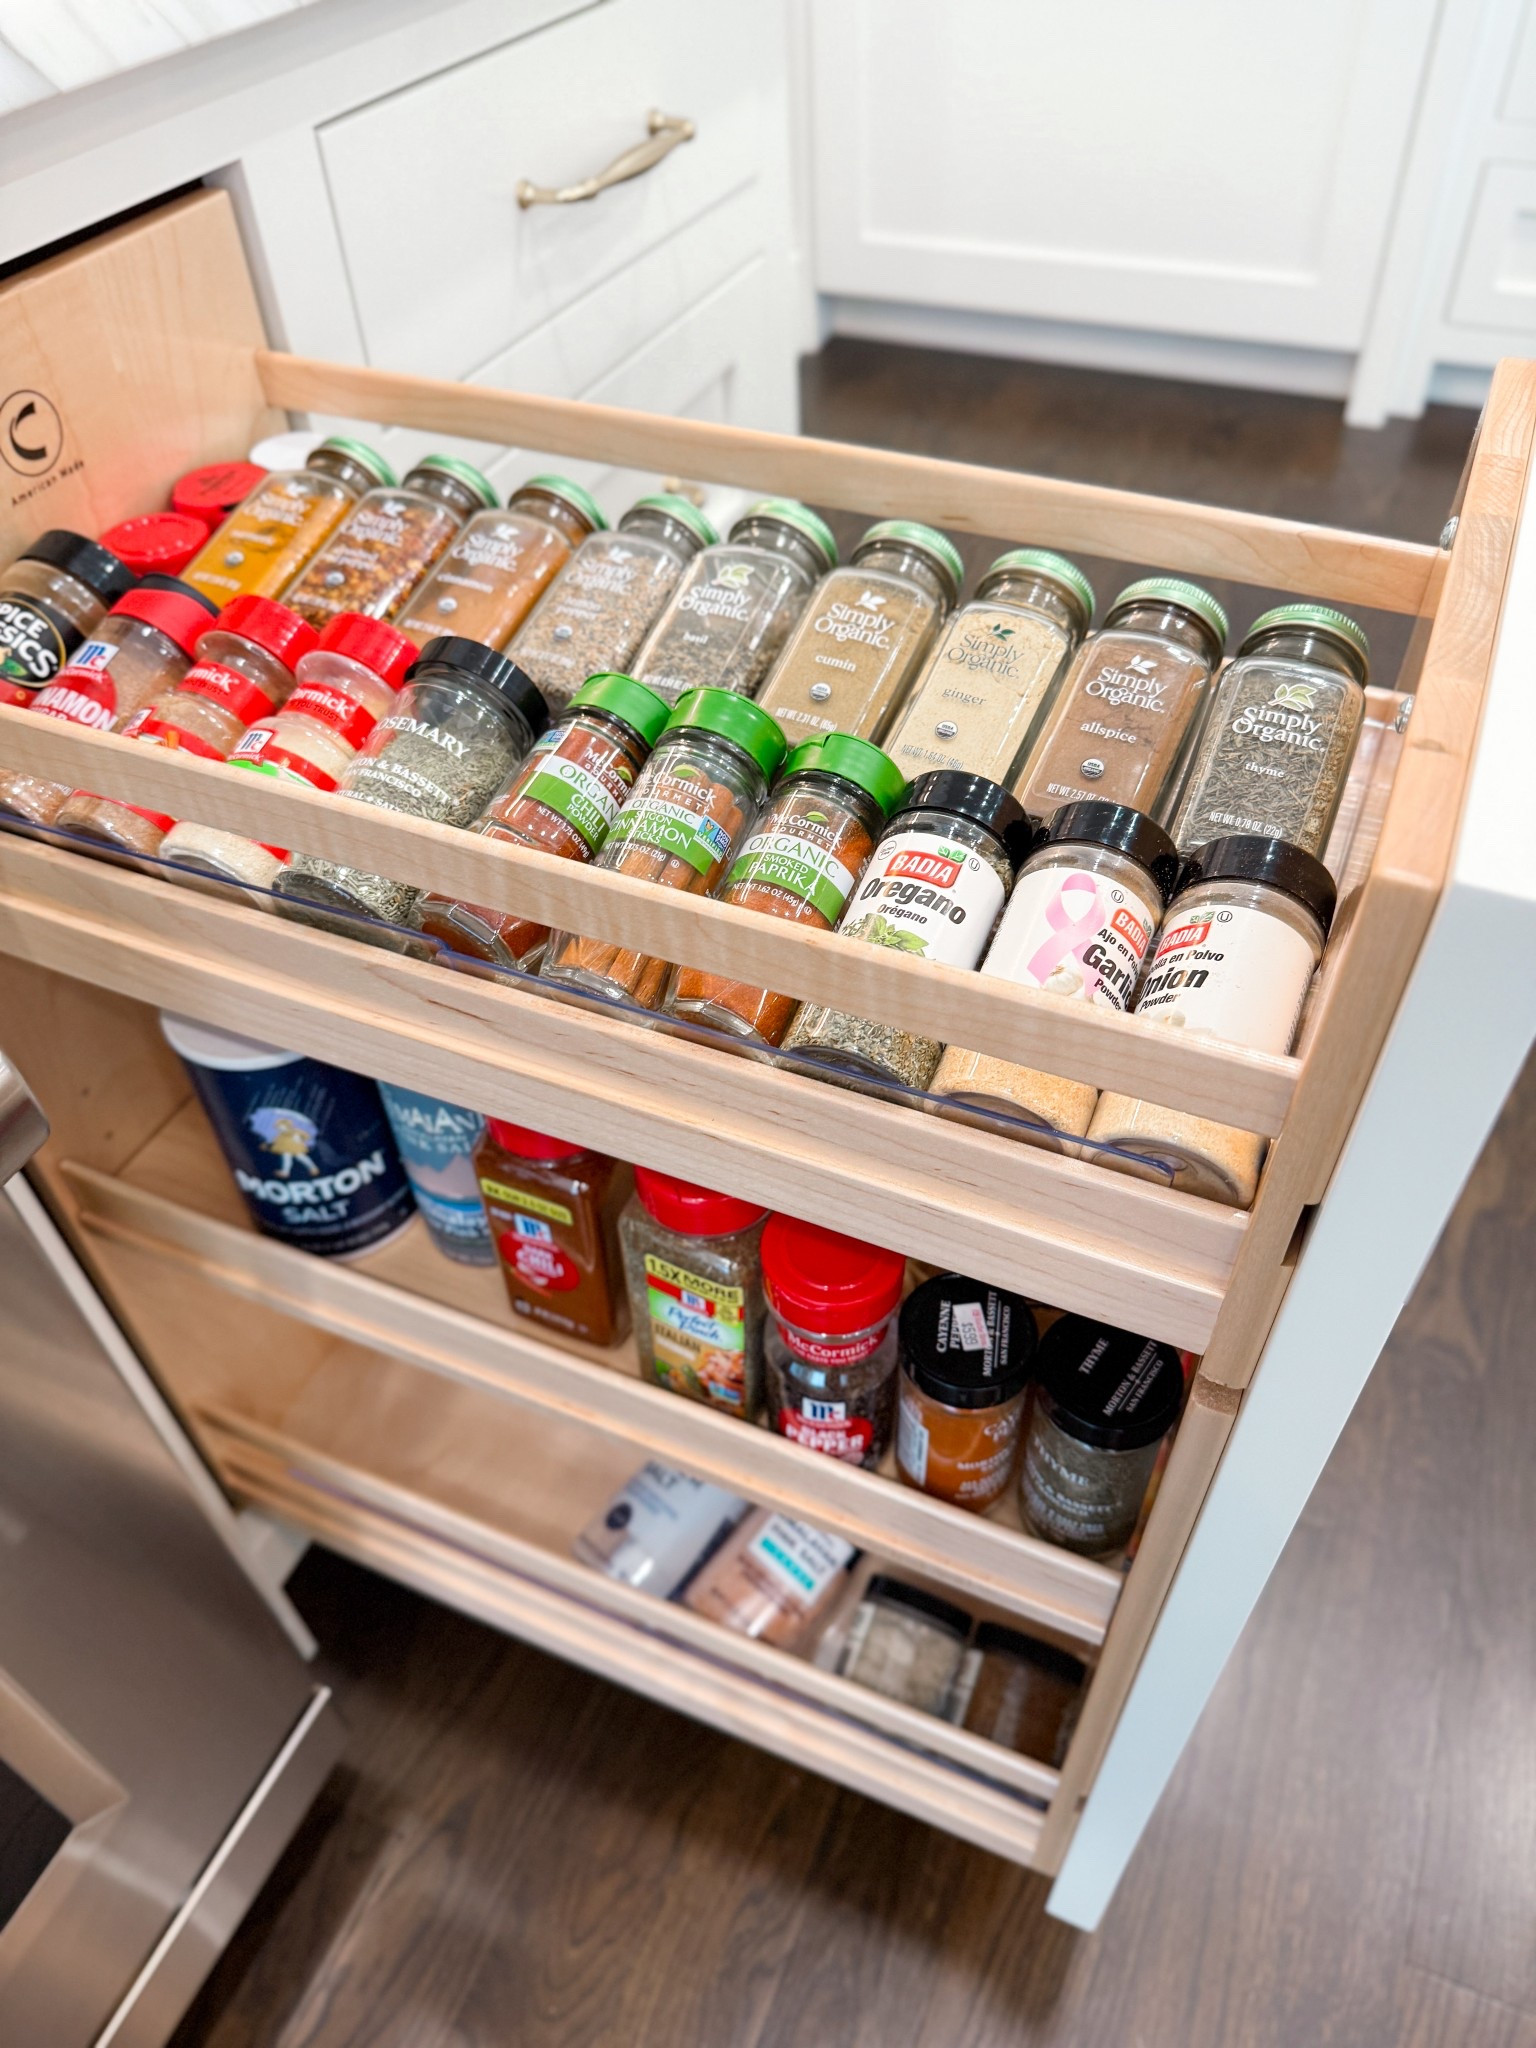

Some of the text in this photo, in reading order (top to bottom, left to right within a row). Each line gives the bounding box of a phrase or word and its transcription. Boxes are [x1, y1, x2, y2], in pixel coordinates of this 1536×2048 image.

[11, 460, 84, 508] American Made
[690, 584, 752, 606] Simply
[827, 602, 895, 632] Simply
[683, 630, 709, 645] basil
[960, 634, 1025, 665] Simply
[815, 654, 856, 672] cumin
[1097, 665, 1168, 699] Simply
[941, 688, 987, 706] ginger
[314, 704, 339, 722] TRUST
[1243, 705, 1323, 735] Simply
[1080, 721, 1137, 744] allspice
[377, 760, 390, 770] &
[902, 744, 914, 756] NET
[923, 749, 936, 762] 1.64
[360, 769, 423, 798] FRANCISCO
[1245, 762, 1285, 778] thyme
[1047, 783, 1059, 795] NET
[566, 803, 599, 841] POWDER
[571, 793, 606, 832] CHILI
[632, 799, 697, 825] ORGANIC
[635, 811, 673, 826] SAIGON
[1209, 811, 1222, 822] NET
[1263, 823, 1283, 839] (22g)
[537, 805, 551, 818] NET
[571, 832, 581, 844] OZ
[578, 842, 591, 859] (49g)
[609, 817, 692, 850] CINNAMON
[627, 830, 663, 844] STICKS
[771, 813, 843, 849] McCormick
[640, 845, 650, 855] OZ
[651, 848, 667, 861] (21g)
[750, 836, 839, 878] ORGANIC
[763, 853, 808, 875] SMOKED
[749, 861, 816, 897] PAPRIKA
[890, 854, 954, 884] BADIA
[757, 884, 770, 894] 1.62
[771, 887, 782, 898] OZ
[782, 892, 800, 907] (45g)
[860, 877, 967, 925] Oregano
[877, 904, 928, 925] Orégano
[1097, 928, 1117, 946] Ajo
[1118, 943, 1129, 957] en
[1115, 911, 1146, 954] BADIA
[1161, 926, 1204, 951] BADIA
[1169, 950, 1225, 964] en Polvo
[1094, 979, 1122, 1012] Powder
[1140, 993, 1180, 1012] Powder
[235, 1151, 387, 1206] MORTON
[281, 1199, 350, 1226] SALT
[683, 1276, 740, 1304] MORE
[987, 1290, 998, 1327] BASSETT
[936, 1299, 952, 1353] CAYENNE
[1001, 1305, 1011, 1348] FRANCISCO
[786, 1328, 879, 1358] McCormick
[1078, 1337, 1109, 1375] THYME
[1102, 1340, 1158, 1417] MORTON & BASSETT
[1125, 1359, 1164, 1414] SAN FRANCISCO
[784, 1424, 865, 1453] PEPPER
